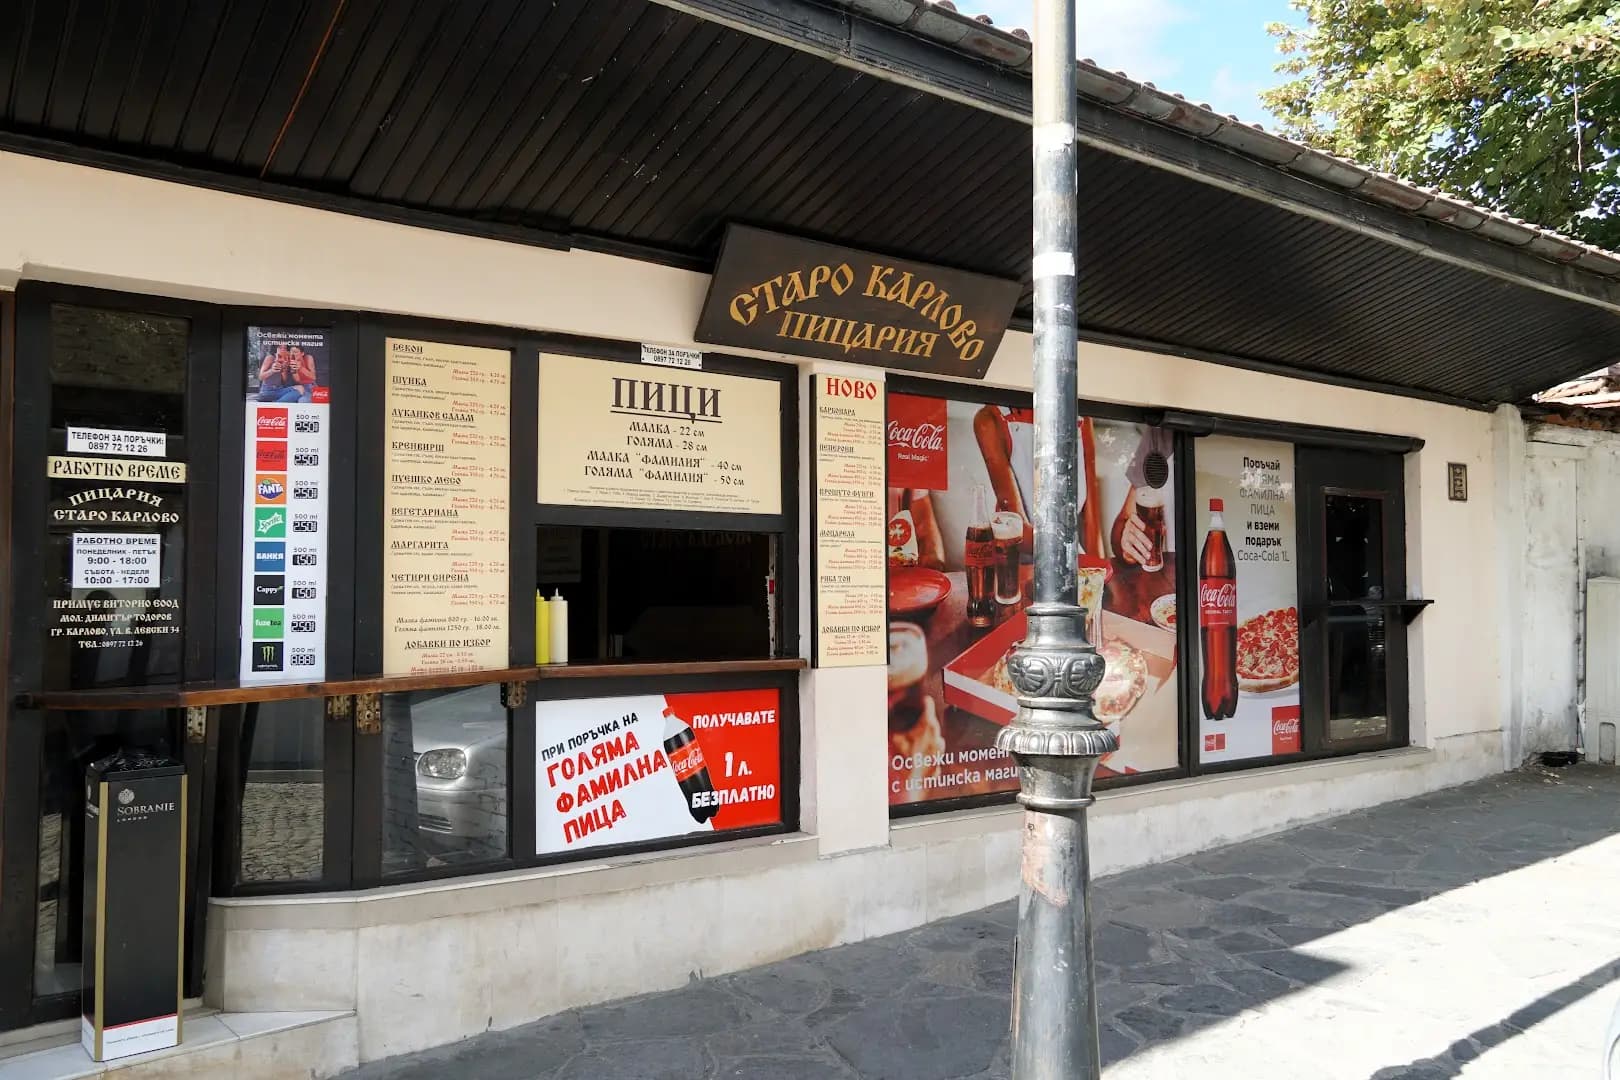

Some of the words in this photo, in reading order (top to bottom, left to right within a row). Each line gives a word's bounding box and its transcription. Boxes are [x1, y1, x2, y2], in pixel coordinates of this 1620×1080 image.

[729, 263, 855, 326] СТАРО
[862, 264, 985, 361] КАРЛОВО
[776, 310, 941, 358] ПИЦАРИЯ
[826, 377, 877, 400] НОВО
[611, 377, 721, 424] ПИЦИ
[72, 431, 110, 440] ТЕЛЕФОН
[112, 432, 122, 442] ЗА
[629, 422, 670, 434] МАЛКА
[680, 426, 690, 436] 22
[88, 442, 109, 450] 0897
[112, 443, 122, 452] 72
[126, 444, 135, 452] 12
[138, 444, 148, 453] 26
[627, 435, 672, 449] ГОЛЯМА
[682, 440, 694, 450] 28
[53, 460, 124, 477] РАБОТНО
[128, 464, 180, 480] ВРЕМЕ
[587, 450, 630, 464] МАЛКА
[717, 460, 728, 470] 40
[1243, 456, 1280, 470] Поръчай
[584, 464, 634, 480] ГОЛЯМА
[720, 476, 731, 486] 50
[67, 487, 164, 508] ПИЦАРИЯ
[54, 509, 108, 521] СТАРО
[111, 510, 180, 524] КАРЛОВО
[1250, 503, 1276, 516] ПИЦА
[1247, 522, 1252, 530] и
[1254, 522, 1280, 530] вземи
[1245, 536, 1282, 548] подарък
[1238, 550, 1280, 562] Coca-Cola
[53, 600, 101, 611] ПРИМУС
[103, 600, 151, 608] ВИТОРНО
[134, 613, 172, 622] ТОДОРОВ
[692, 710, 776, 729] ПОЛУЧАВАТЕ
[542, 742, 565, 761] ПРИ
[568, 721, 620, 750] ПОРЪЧКА
[623, 712, 639, 728] НА
[546, 730, 640, 788] ГОЛЯМА
[724, 752, 734, 778] 1
[892, 752, 954, 770] Освежи
[958, 748, 1009, 764] момен
[556, 749, 669, 813] ФАМИЛНА
[892, 781, 900, 792] с
[906, 768, 980, 791] истинска
[985, 766, 1018, 782] маги
[692, 784, 776, 808] БЕЗПЛАТНО
[117, 802, 175, 816] SOBRANIE
[563, 799, 628, 844] ПИЦА
